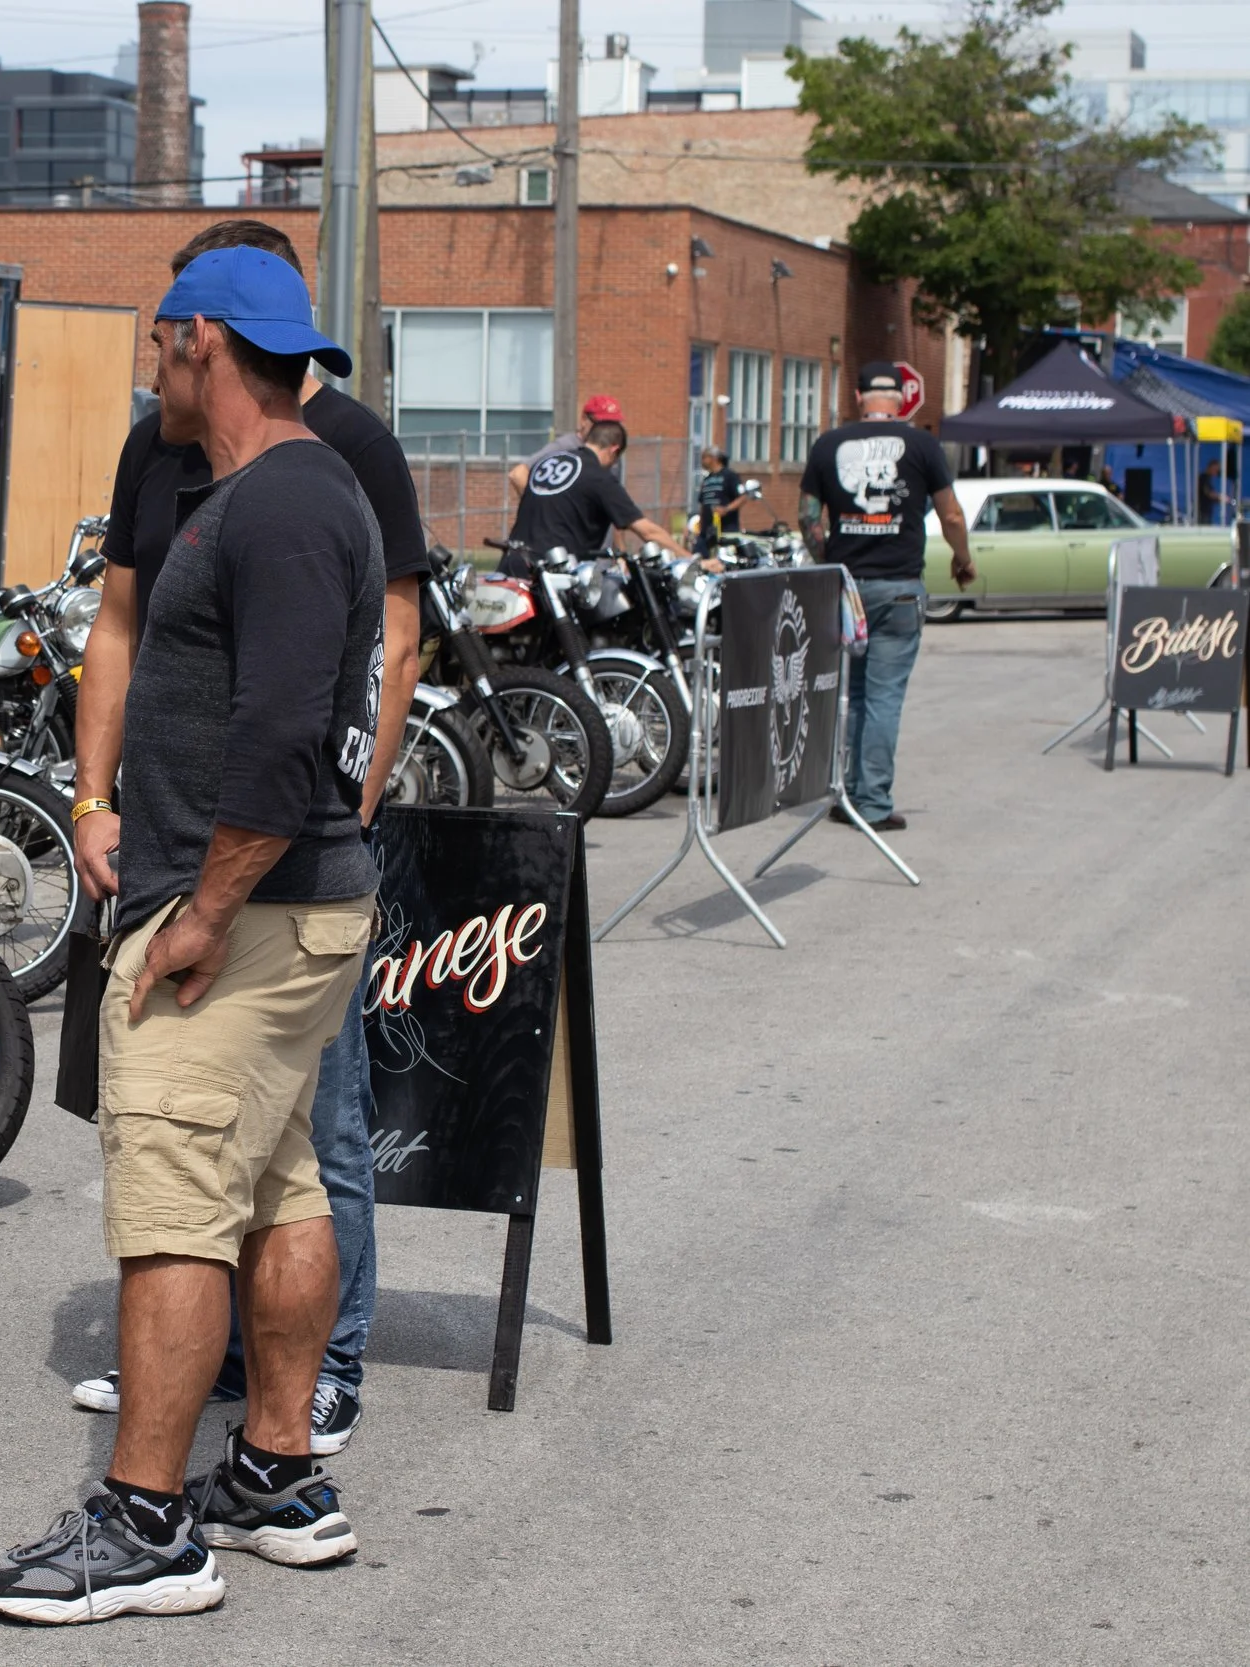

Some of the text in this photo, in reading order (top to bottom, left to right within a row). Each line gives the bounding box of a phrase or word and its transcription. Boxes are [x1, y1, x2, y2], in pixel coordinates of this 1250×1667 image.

[535, 458, 574, 486] 59
[1120, 609, 1239, 674] British
[726, 685, 768, 710] PROGRESSIVE
[361, 902, 547, 1014] anese
[74, 1549, 110, 1562] FILA
